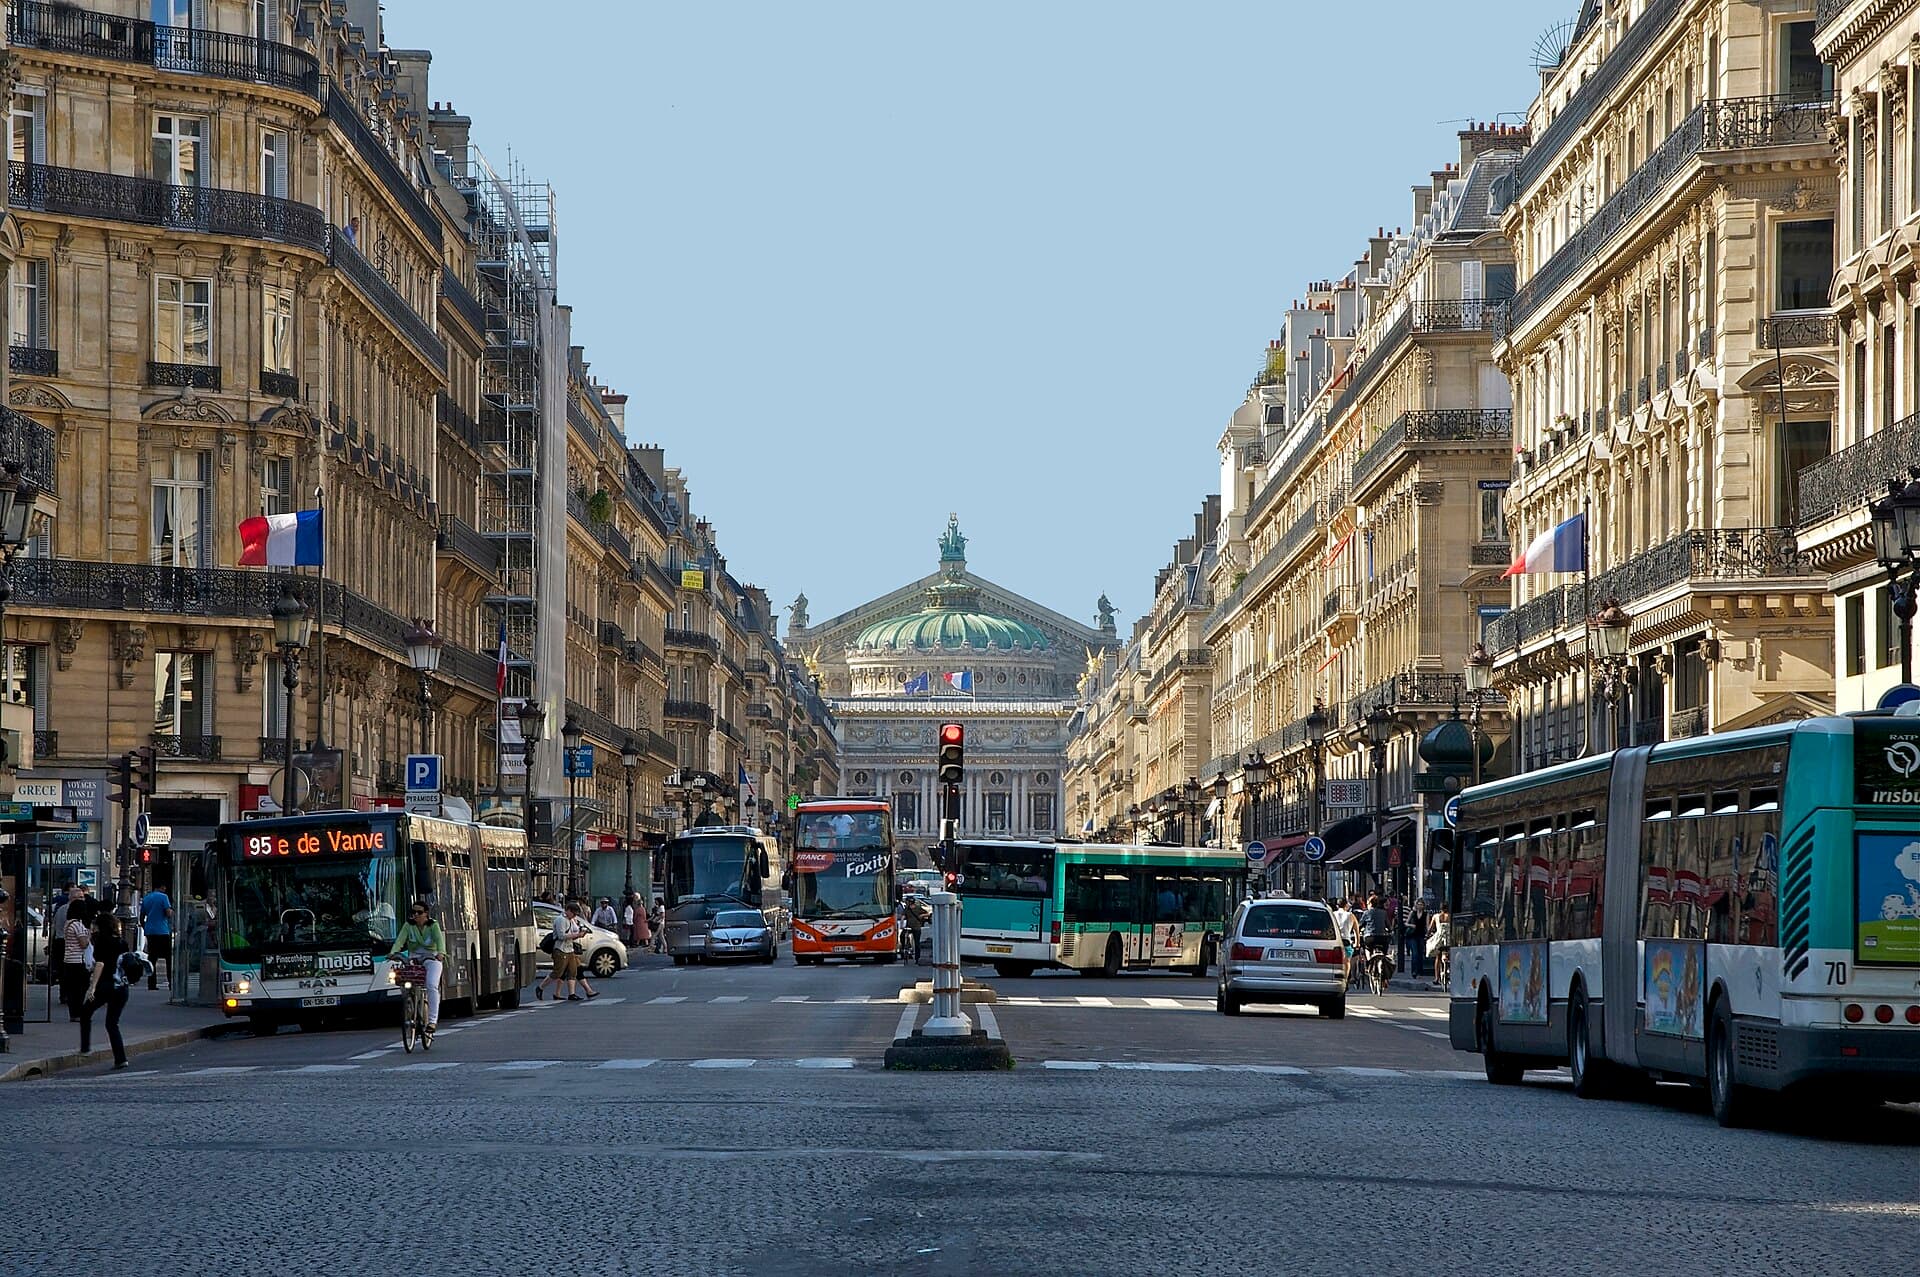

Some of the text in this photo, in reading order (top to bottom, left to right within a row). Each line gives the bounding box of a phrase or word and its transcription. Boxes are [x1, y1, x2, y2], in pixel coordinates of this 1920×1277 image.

[415, 762, 430, 785] P
[18, 785, 57, 796] GRECE
[67, 781, 97, 789] VOYAGES
[68, 790, 96, 798] DANS LE
[406, 794, 438, 802] PYRAMIDES
[70, 799, 93, 807] MONDE
[249, 830, 385, 856] 95 e de Vanve
[846, 853, 891, 879] Foxity
[1029, 924, 1039, 932] 21
[318, 953, 371, 970] mayas
[1824, 961, 1847, 986] 70
[299, 978, 338, 989] MAN
